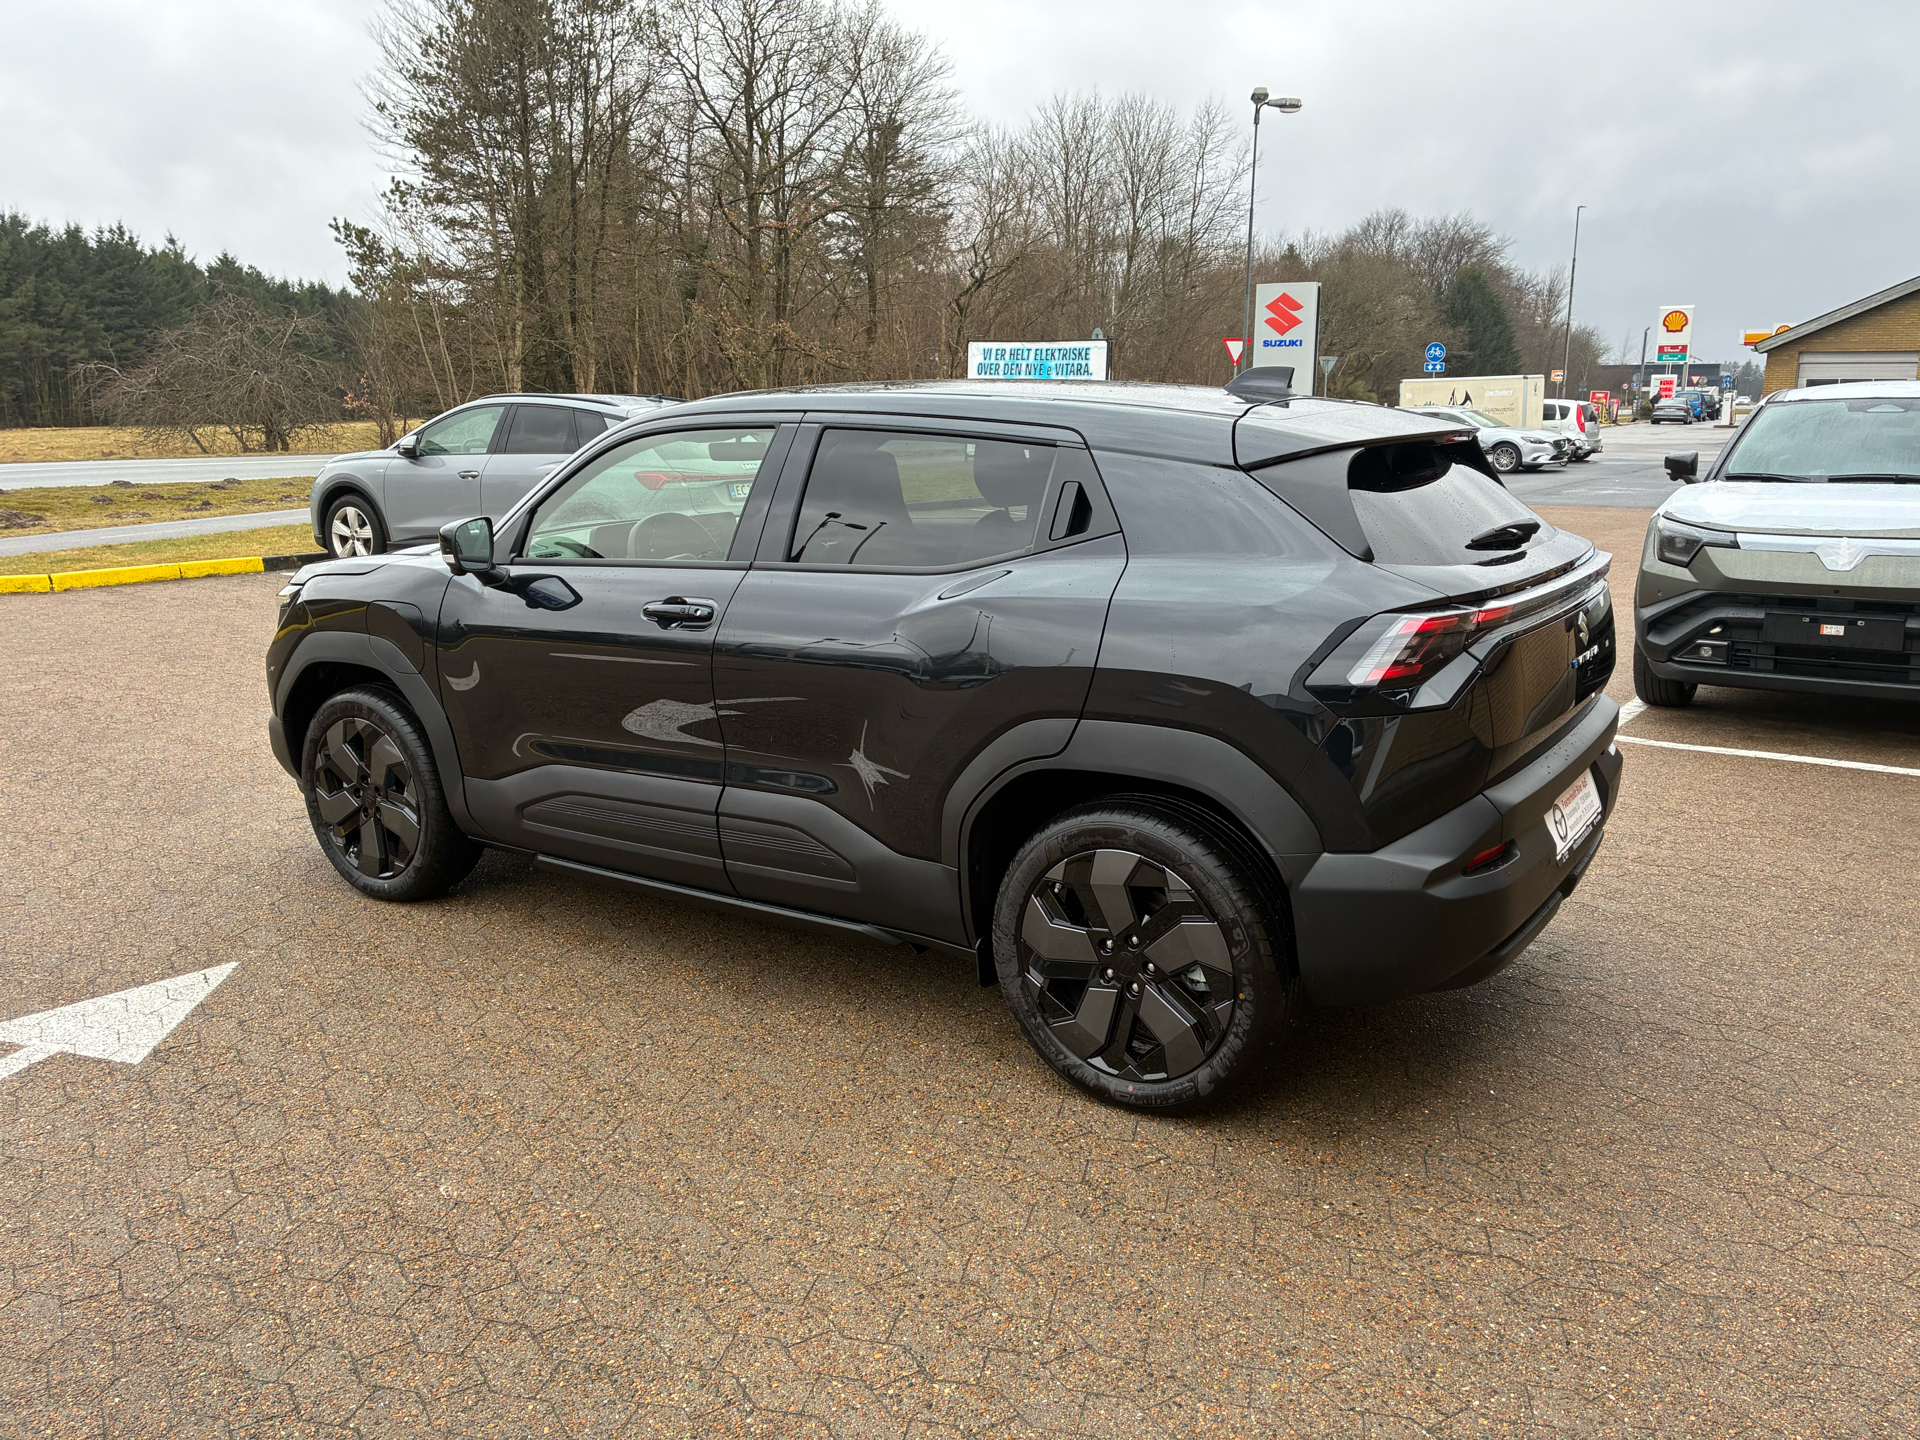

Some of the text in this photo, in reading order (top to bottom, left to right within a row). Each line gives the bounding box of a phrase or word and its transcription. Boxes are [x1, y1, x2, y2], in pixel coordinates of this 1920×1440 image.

[1262, 339, 1303, 347] SUZUKI
[983, 347, 1091, 361] VI ER HELT ELEKTRISKE
[977, 363, 1093, 376] OVER DEN NYE e VITARA.
